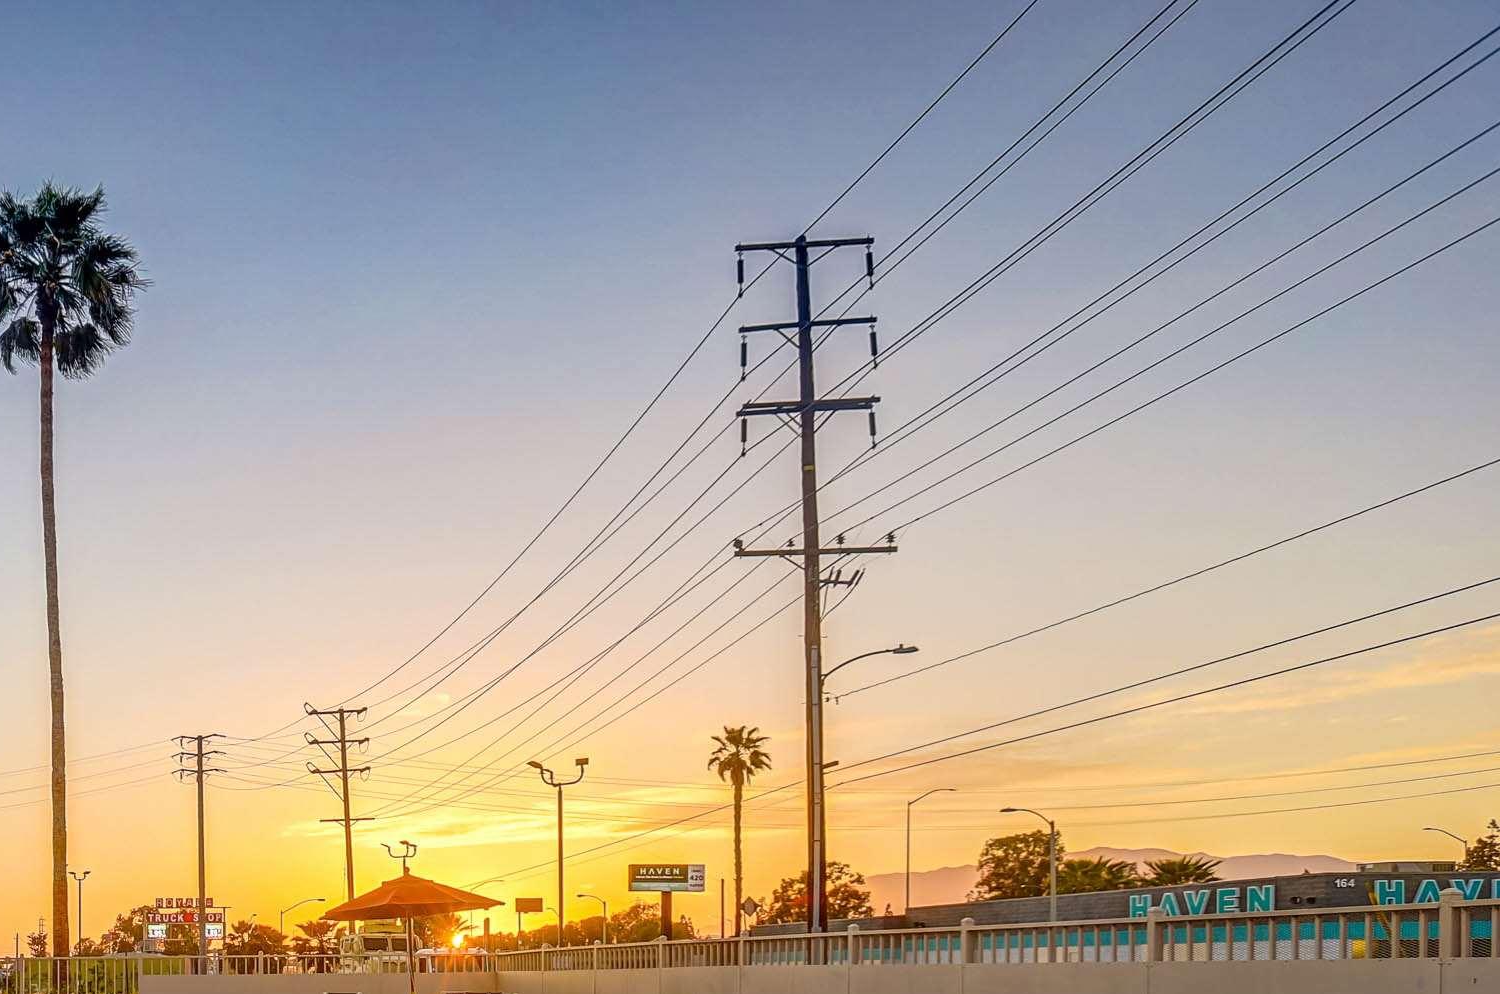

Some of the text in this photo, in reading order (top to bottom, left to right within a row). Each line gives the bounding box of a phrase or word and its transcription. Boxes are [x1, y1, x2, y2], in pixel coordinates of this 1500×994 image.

[1334, 878, 1356, 888] 164
[1130, 885, 1275, 918] HAVEN
[148, 913, 222, 922] TRUCK SOP
